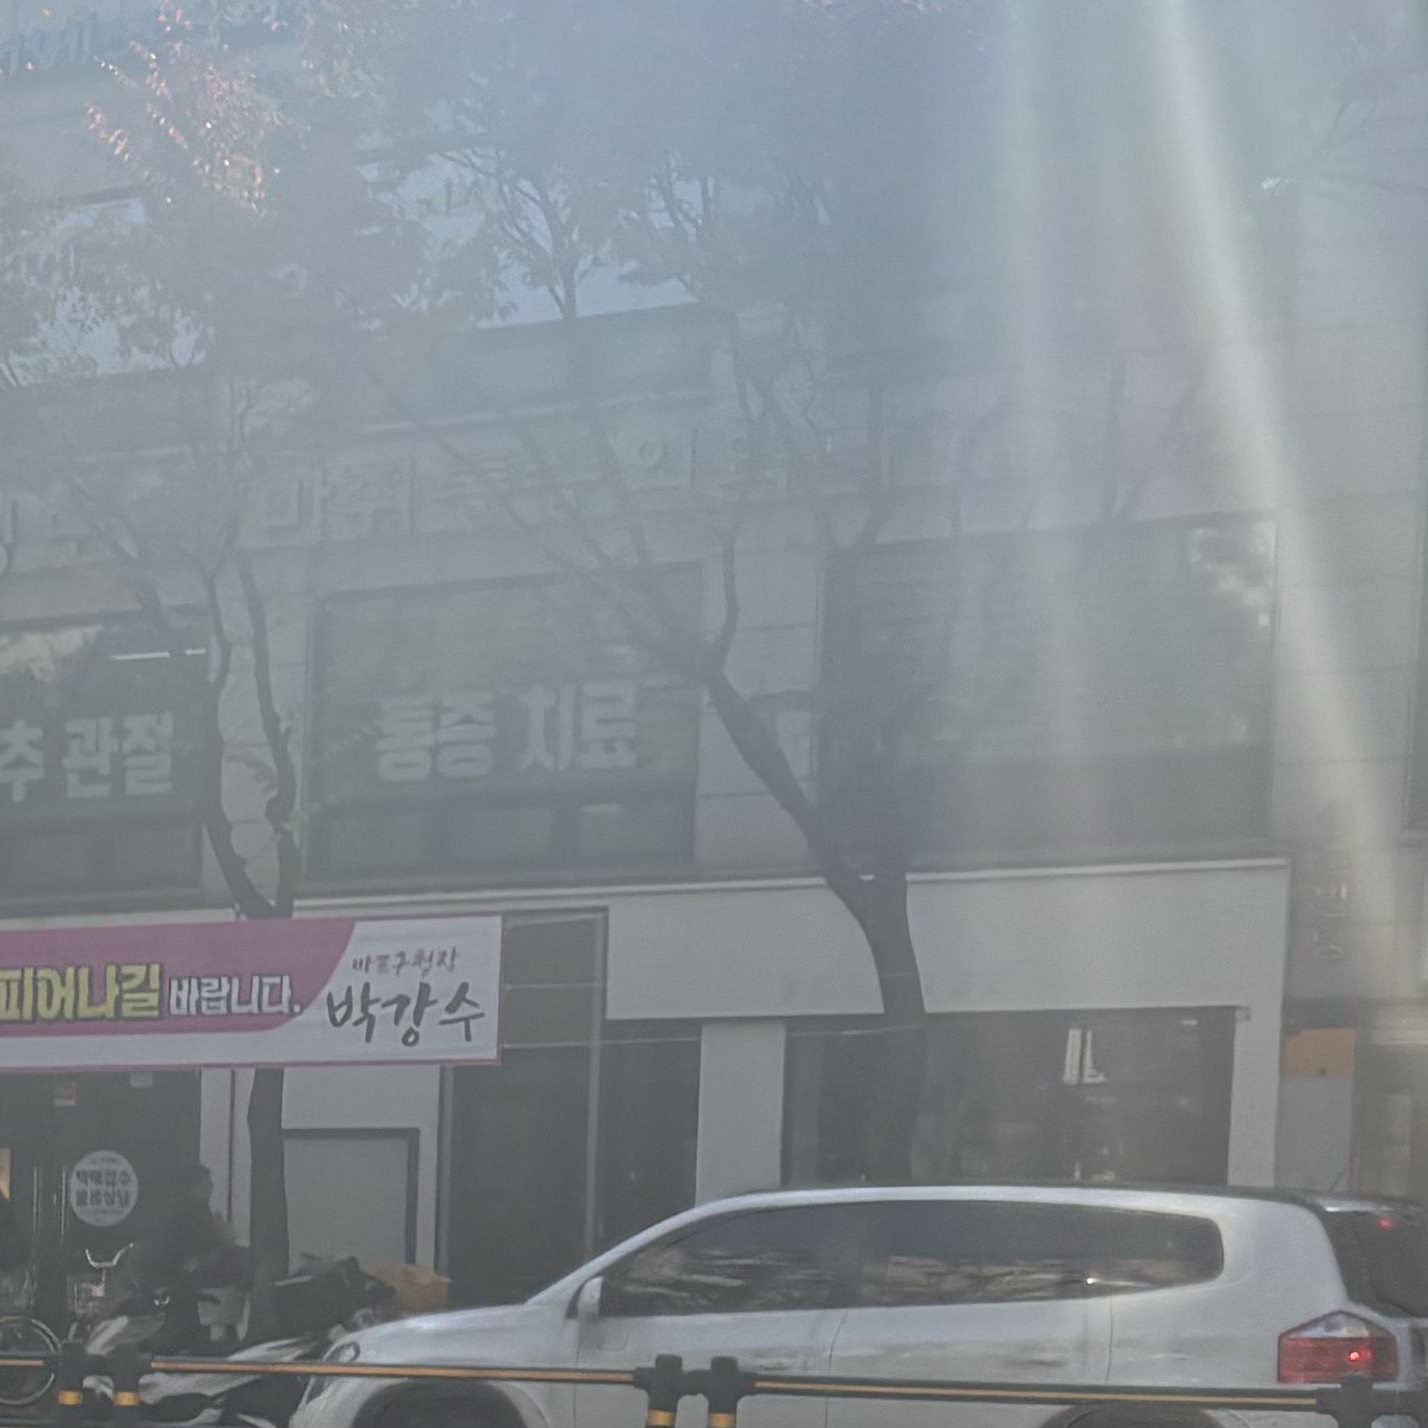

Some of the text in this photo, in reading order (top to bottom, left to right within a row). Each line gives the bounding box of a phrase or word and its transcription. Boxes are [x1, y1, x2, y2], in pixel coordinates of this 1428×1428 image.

[62, 712, 174, 799] 관절
[375, 680, 638, 783] 통증 치료
[169, 974, 303, 1016] 바랍니다.
[324, 981, 486, 1047] 박강수
